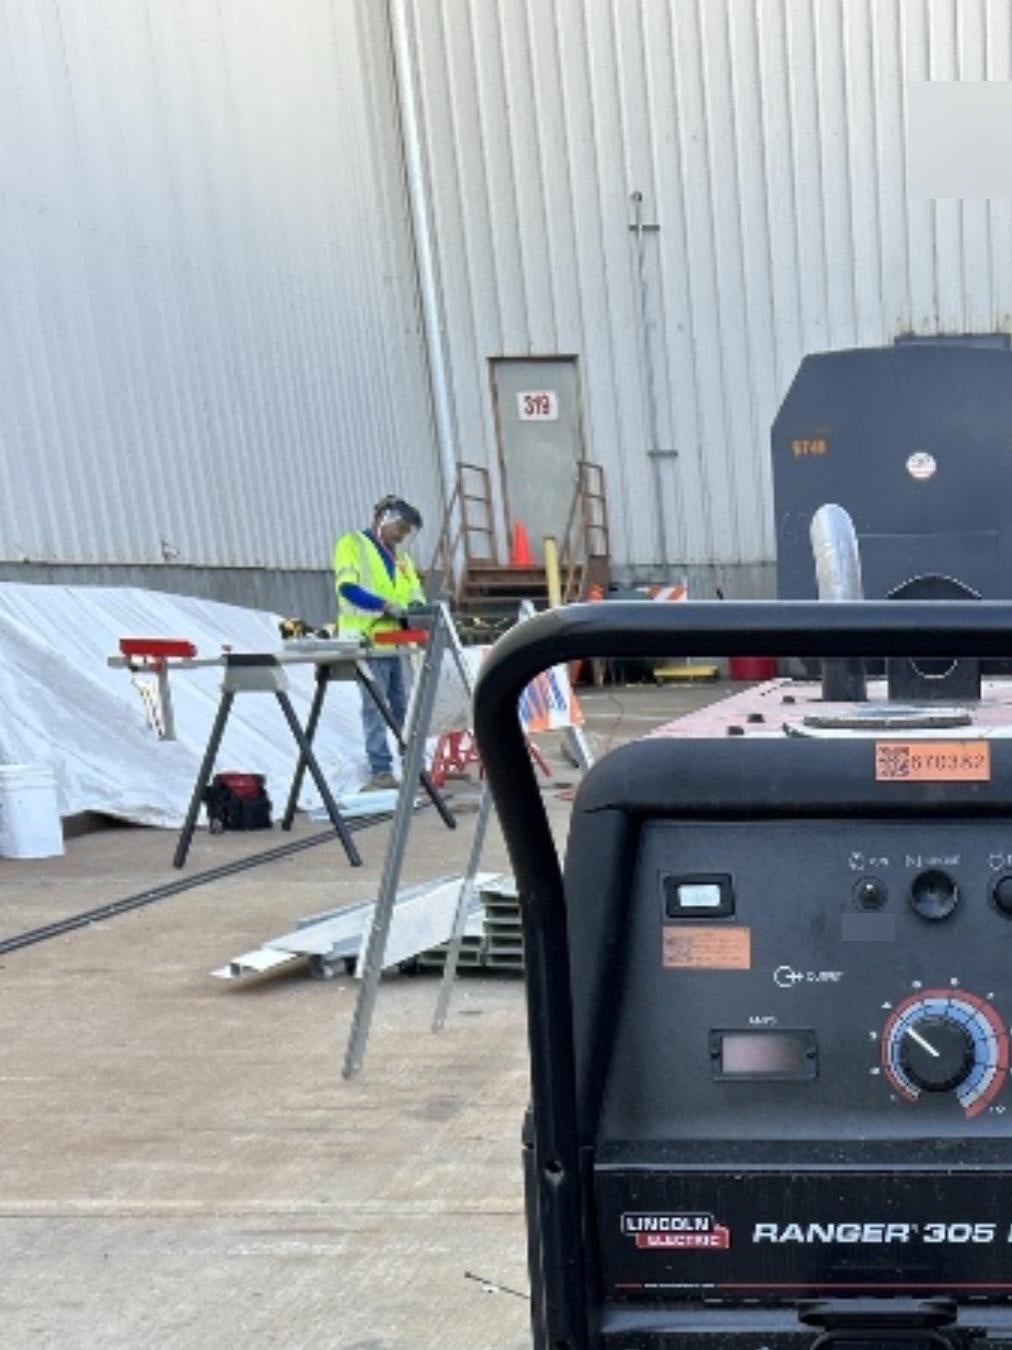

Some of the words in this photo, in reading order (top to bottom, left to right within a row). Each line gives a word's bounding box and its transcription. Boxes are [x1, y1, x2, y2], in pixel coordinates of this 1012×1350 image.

[626, 1217, 709, 1231] LINCOLN
[752, 1223, 909, 1243] RANGER
[923, 1223, 996, 1243] 305
